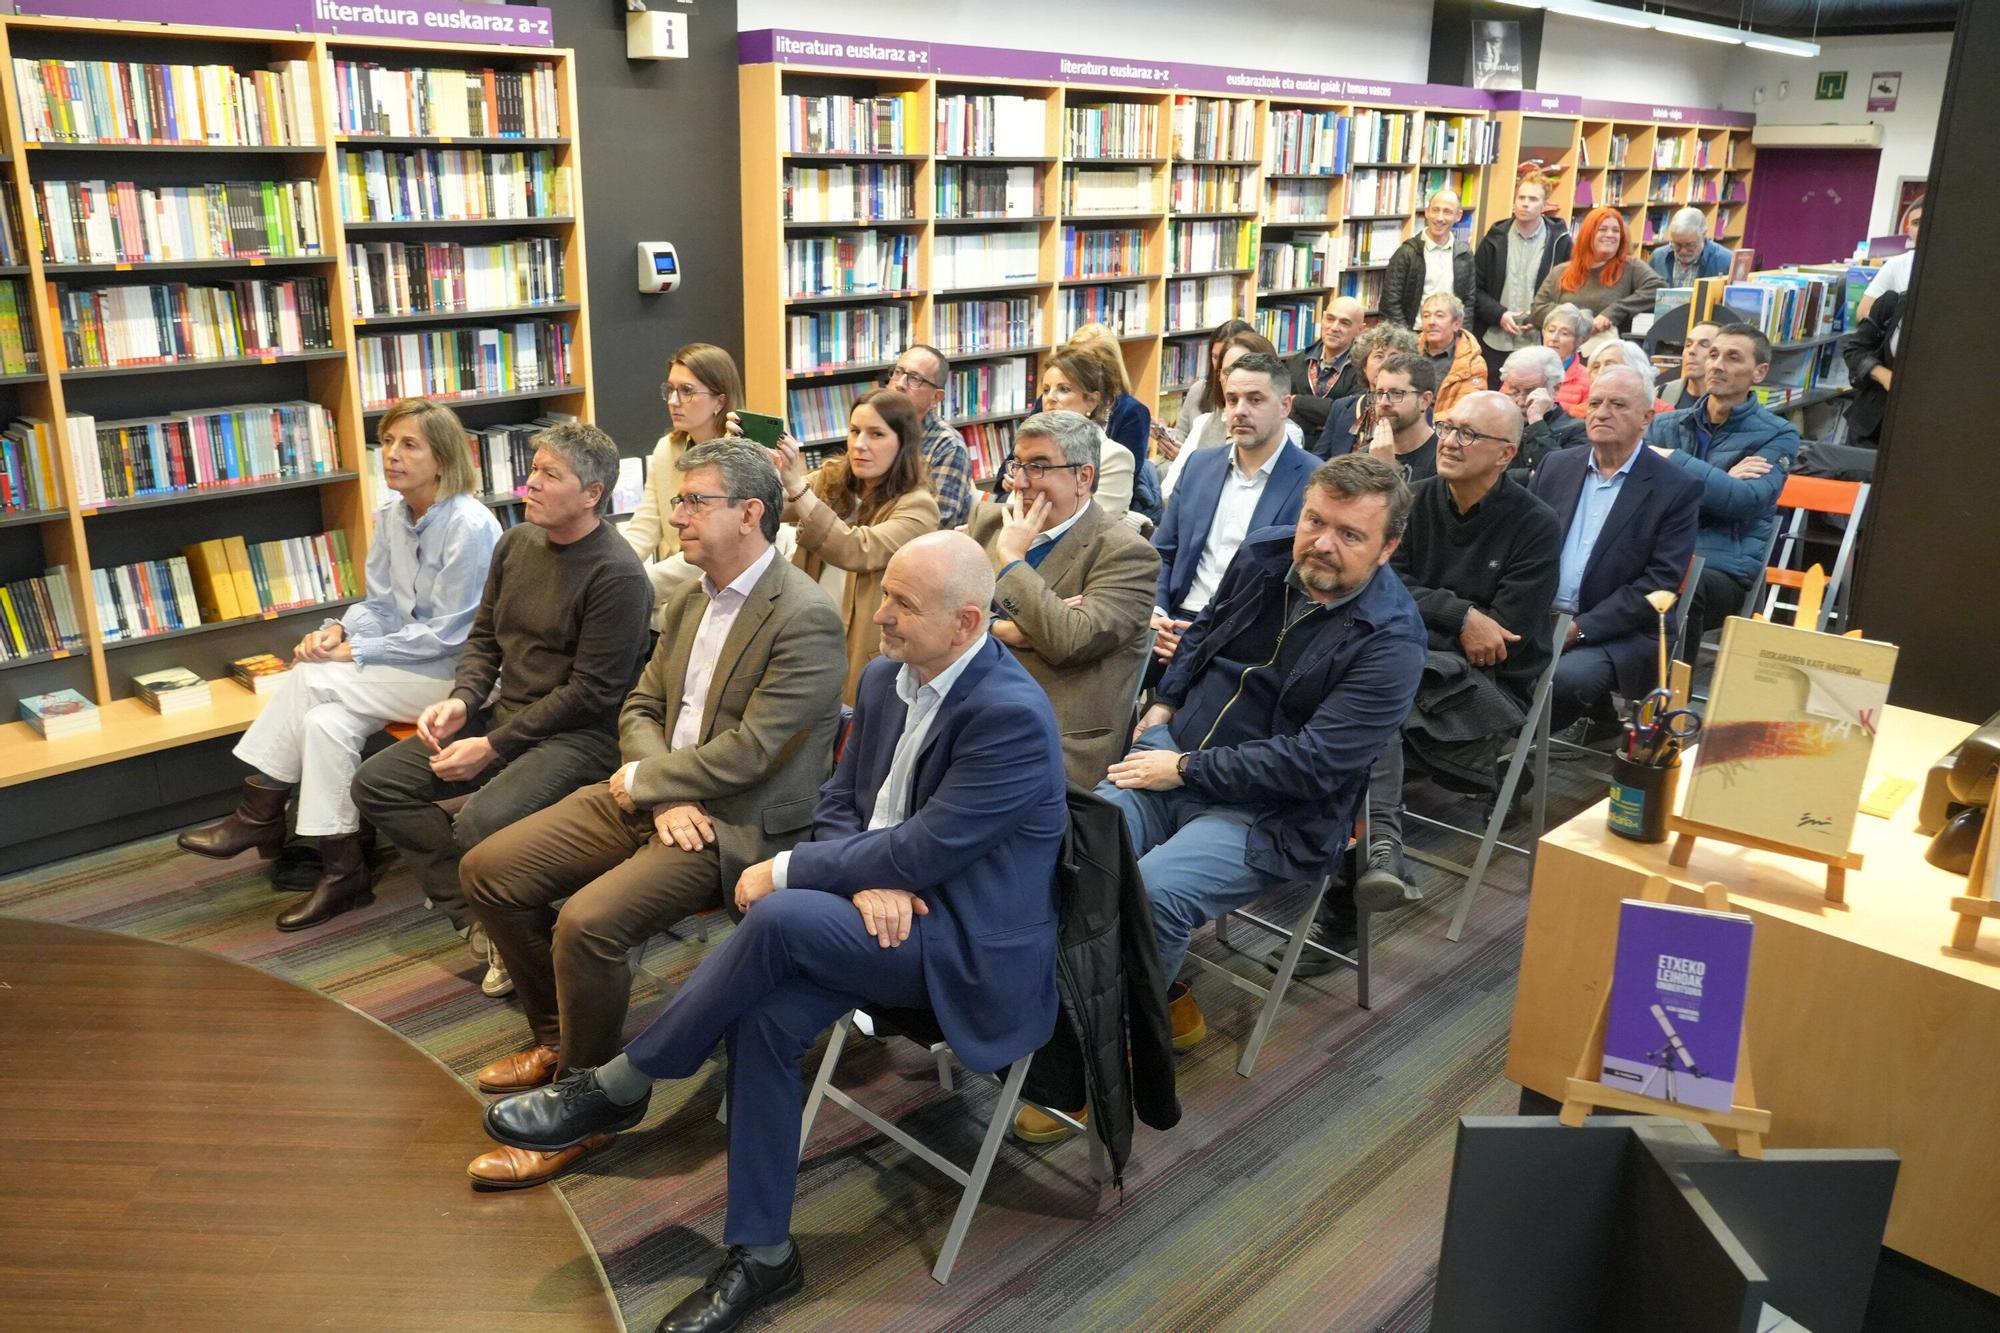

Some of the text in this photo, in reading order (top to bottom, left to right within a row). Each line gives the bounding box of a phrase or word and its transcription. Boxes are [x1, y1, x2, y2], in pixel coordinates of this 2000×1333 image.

[316, 0, 549, 35] literatura euskaraz a-z
[776, 35, 928, 64] literatura euskaraz a-z
[1060, 58, 1169, 81] literatura euskaraz a-z
[1226, 73, 1281, 90] euskarazkoak
[1282, 78, 1295, 90] eta
[1296, 78, 1319, 92] euskal
[1320, 79, 1340, 95] gaiak
[1658, 954, 1706, 976] ETXEKO
